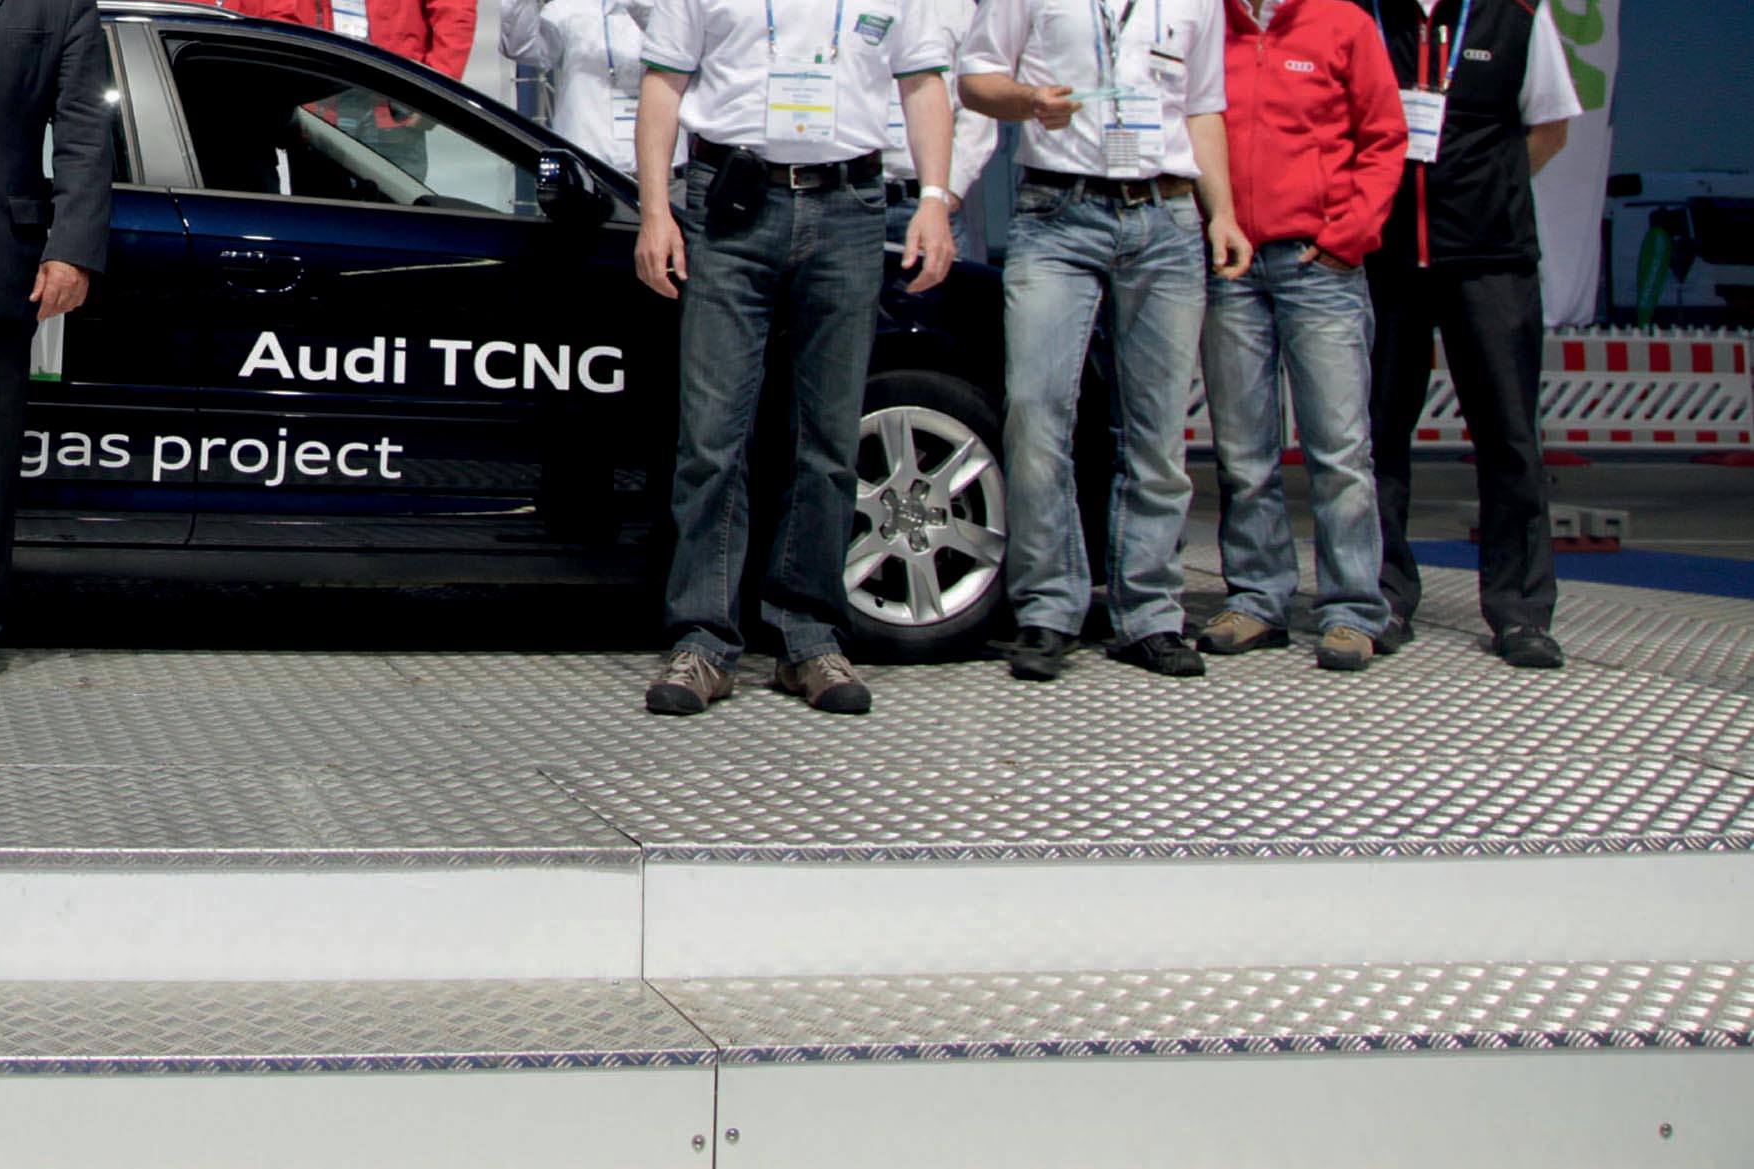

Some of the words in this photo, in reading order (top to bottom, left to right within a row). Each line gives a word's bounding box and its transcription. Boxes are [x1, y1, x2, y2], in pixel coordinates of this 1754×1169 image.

[238, 331, 406, 384] Audi
[430, 338, 625, 393] TCNG
[21, 430, 131, 478] gas
[152, 427, 403, 487] project
